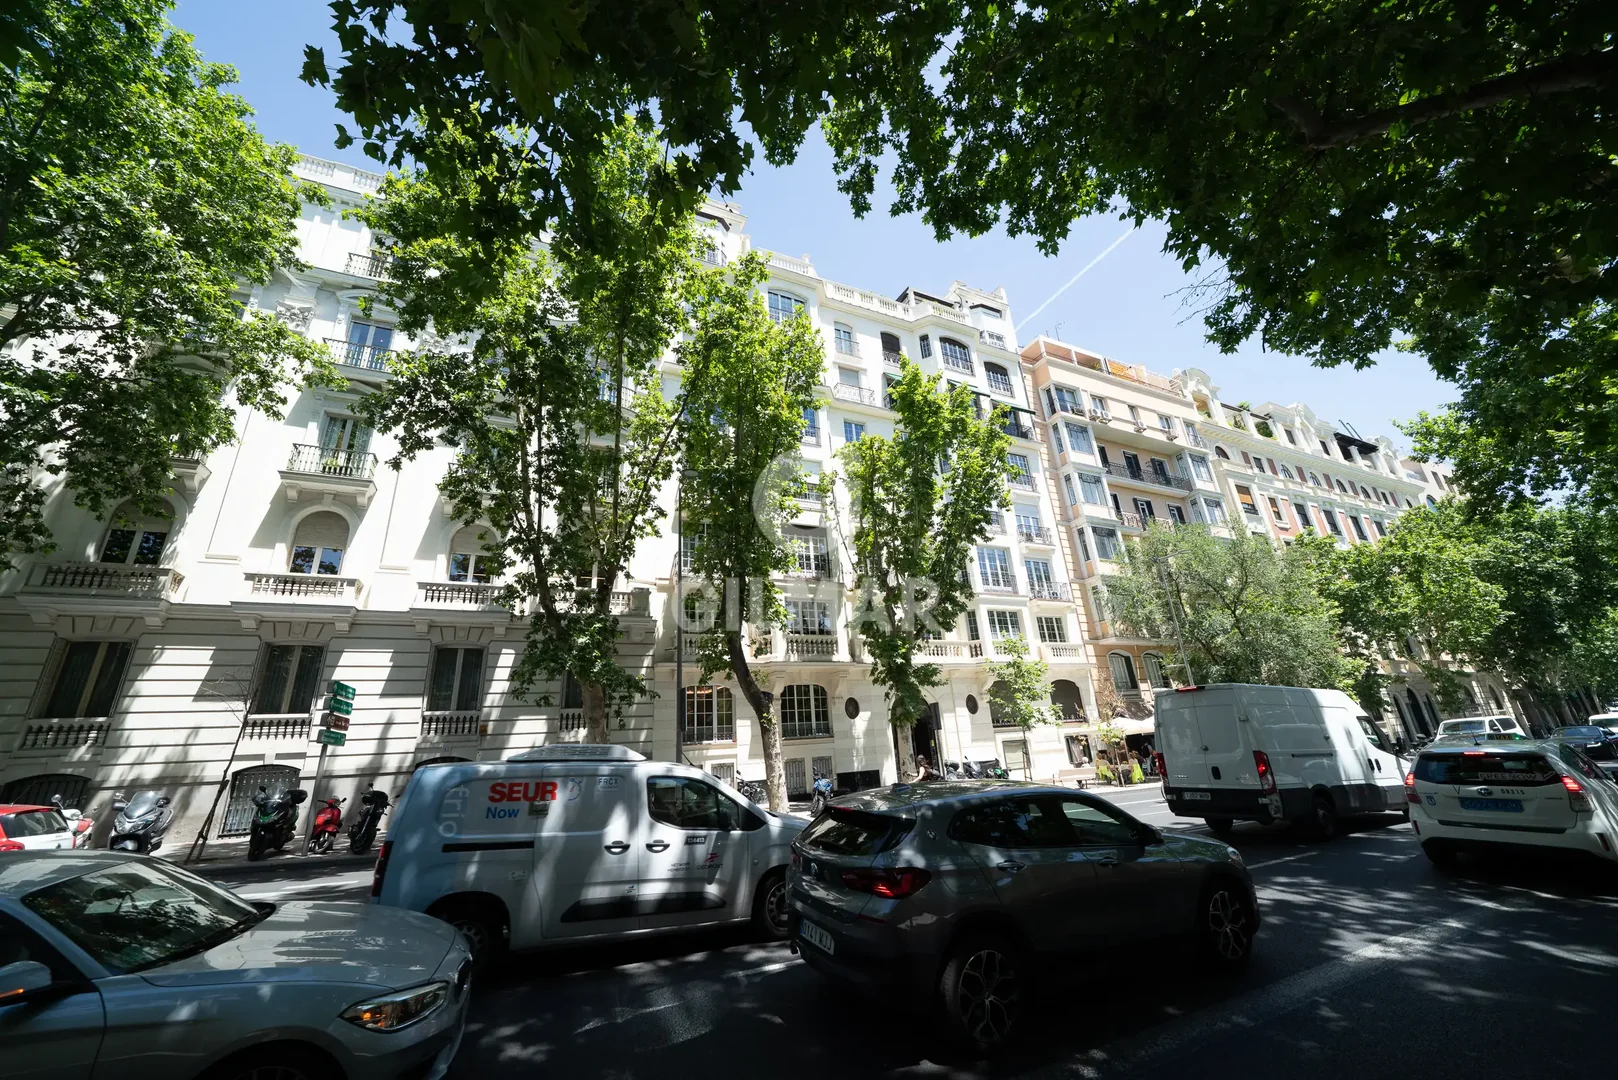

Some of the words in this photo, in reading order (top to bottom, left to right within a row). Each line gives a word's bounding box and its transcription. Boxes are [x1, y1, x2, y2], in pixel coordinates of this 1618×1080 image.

[598, 777, 619, 785] FRCX
[488, 782, 559, 803] SEUR
[486, 806, 520, 819] Now
